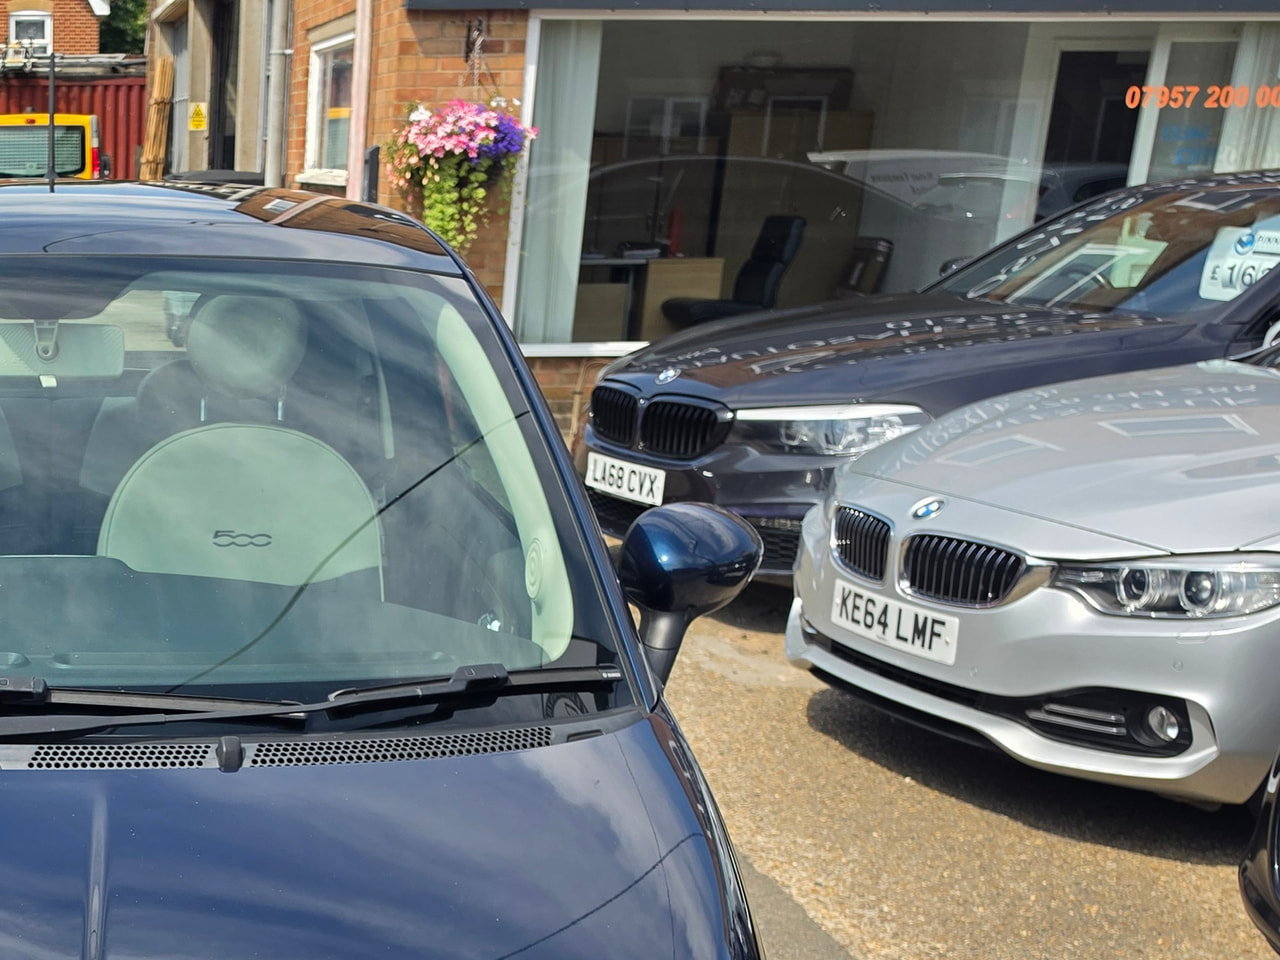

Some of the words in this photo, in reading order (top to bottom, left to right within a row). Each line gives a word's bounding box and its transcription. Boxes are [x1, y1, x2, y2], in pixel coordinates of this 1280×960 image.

[1125, 85, 1200, 109] 07957
[1203, 85, 1250, 108] 200
[593, 459, 624, 489] LA68
[627, 470, 658, 499] CVX
[212, 530, 272, 547] 500
[839, 587, 888, 635] KE64
[896, 608, 946, 651] LMF
